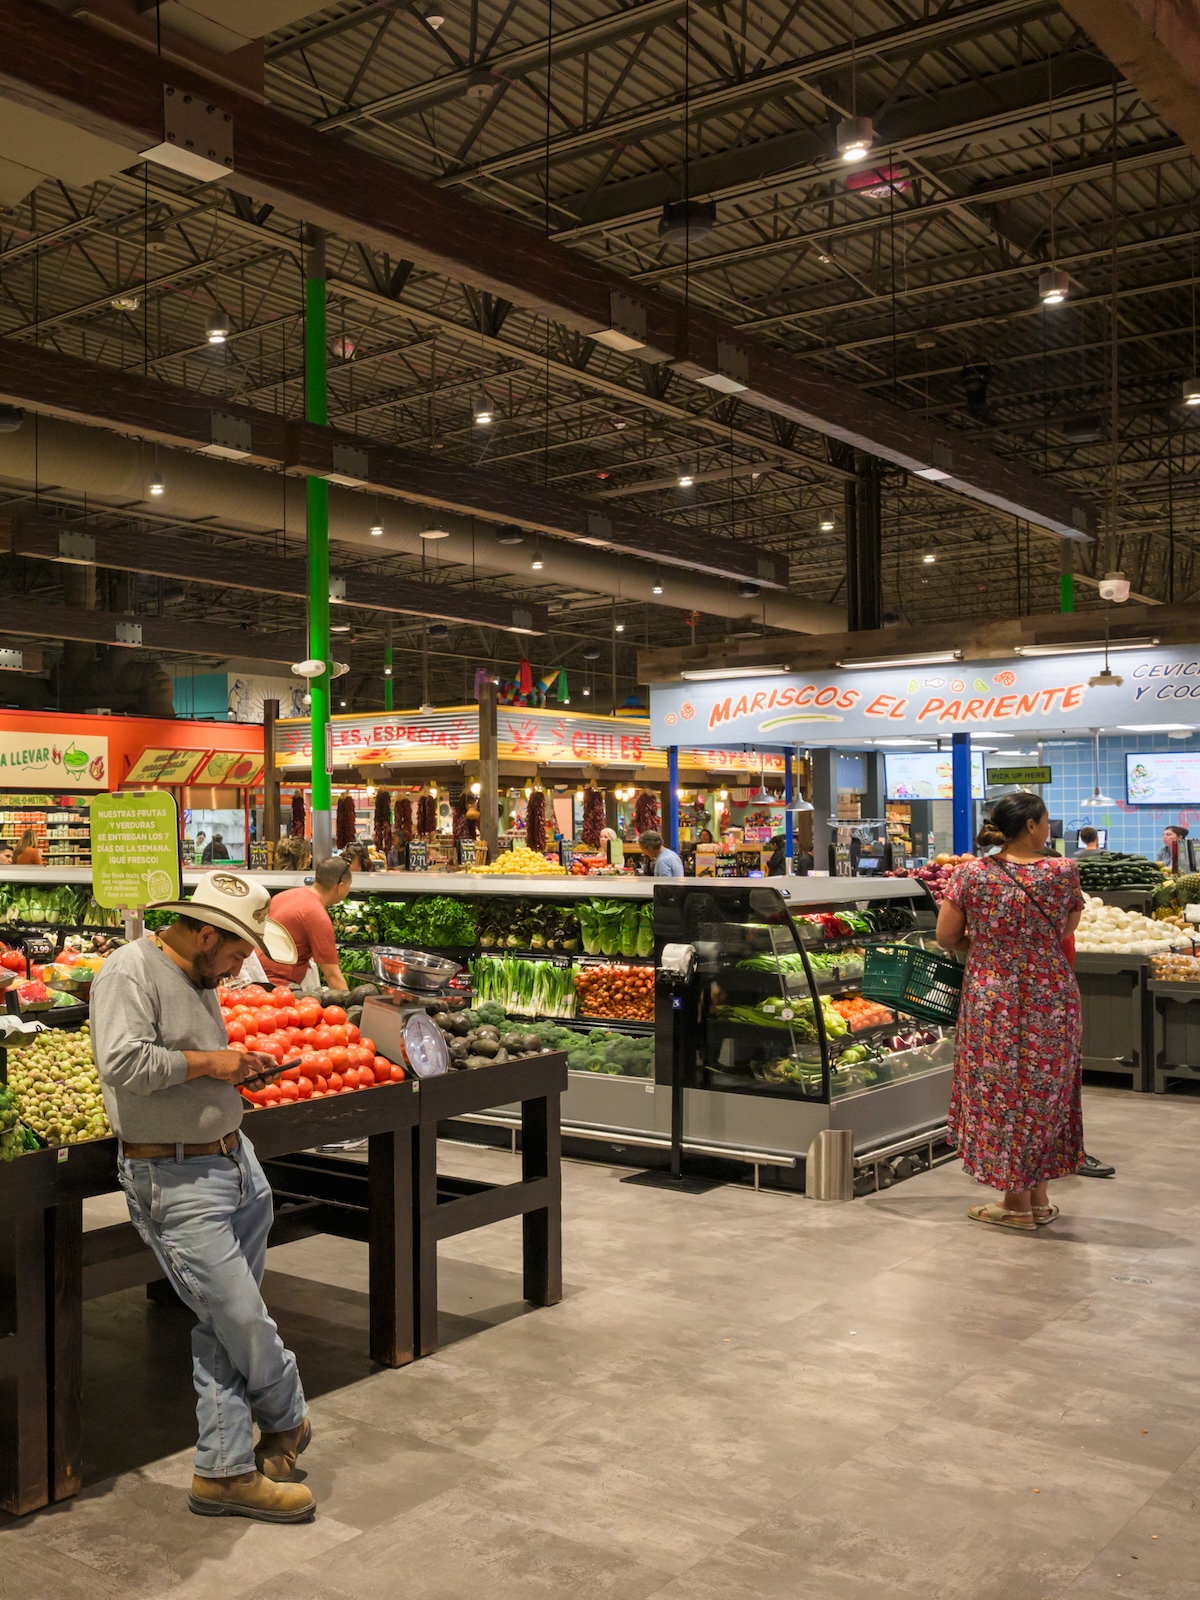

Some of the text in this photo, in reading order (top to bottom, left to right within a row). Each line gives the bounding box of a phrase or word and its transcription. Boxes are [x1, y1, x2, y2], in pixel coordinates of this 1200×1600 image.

[1132, 662, 1200, 678] CEVIC
[1135, 687, 1151, 700] Y
[708, 684, 1084, 728] MARISCOS EL PARIENTE
[301, 729, 361, 757] CLES
[373, 726, 461, 751] ESPECIAS
[571, 731, 643, 761] CHILES
[10, 747, 50, 767] LLEVAR
[98, 809, 167, 818] NUESTRAS FRUTAS
[116, 821, 155, 829] VERDURAS
[108, 833, 147, 841] ENTREGAN
[97, 844, 114, 853] DÍAS
[137, 845, 171, 853] SEMANA.
[109, 855, 159, 864] ¡QUÉ FRESCO!
